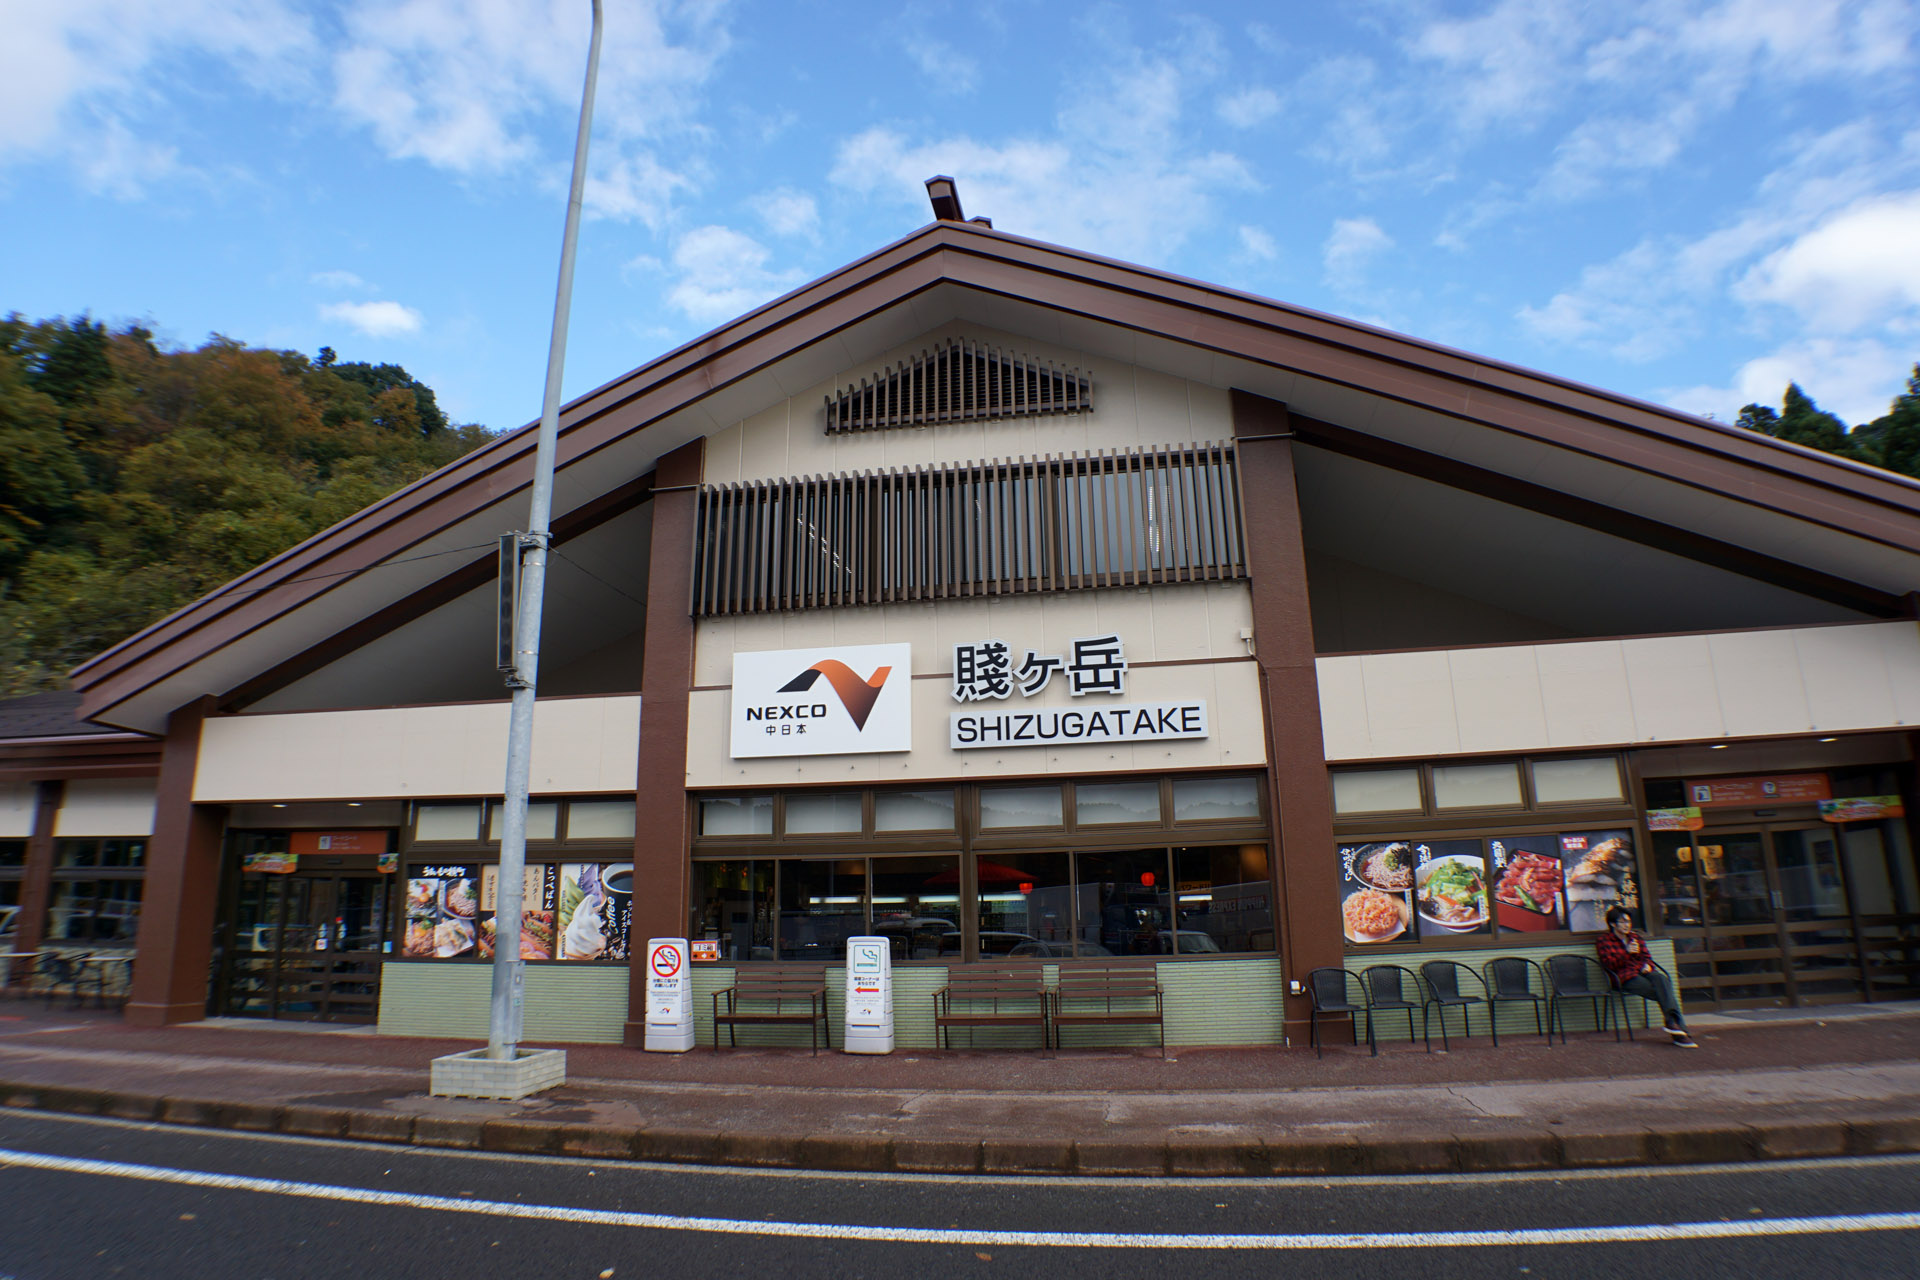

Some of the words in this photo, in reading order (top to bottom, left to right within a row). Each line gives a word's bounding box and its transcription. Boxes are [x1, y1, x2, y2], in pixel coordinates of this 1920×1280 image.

[746, 703, 828, 721] NEXCO
[765, 723, 807, 736] 中日本
[957, 706, 1202, 743] SHIZUGATAKE
